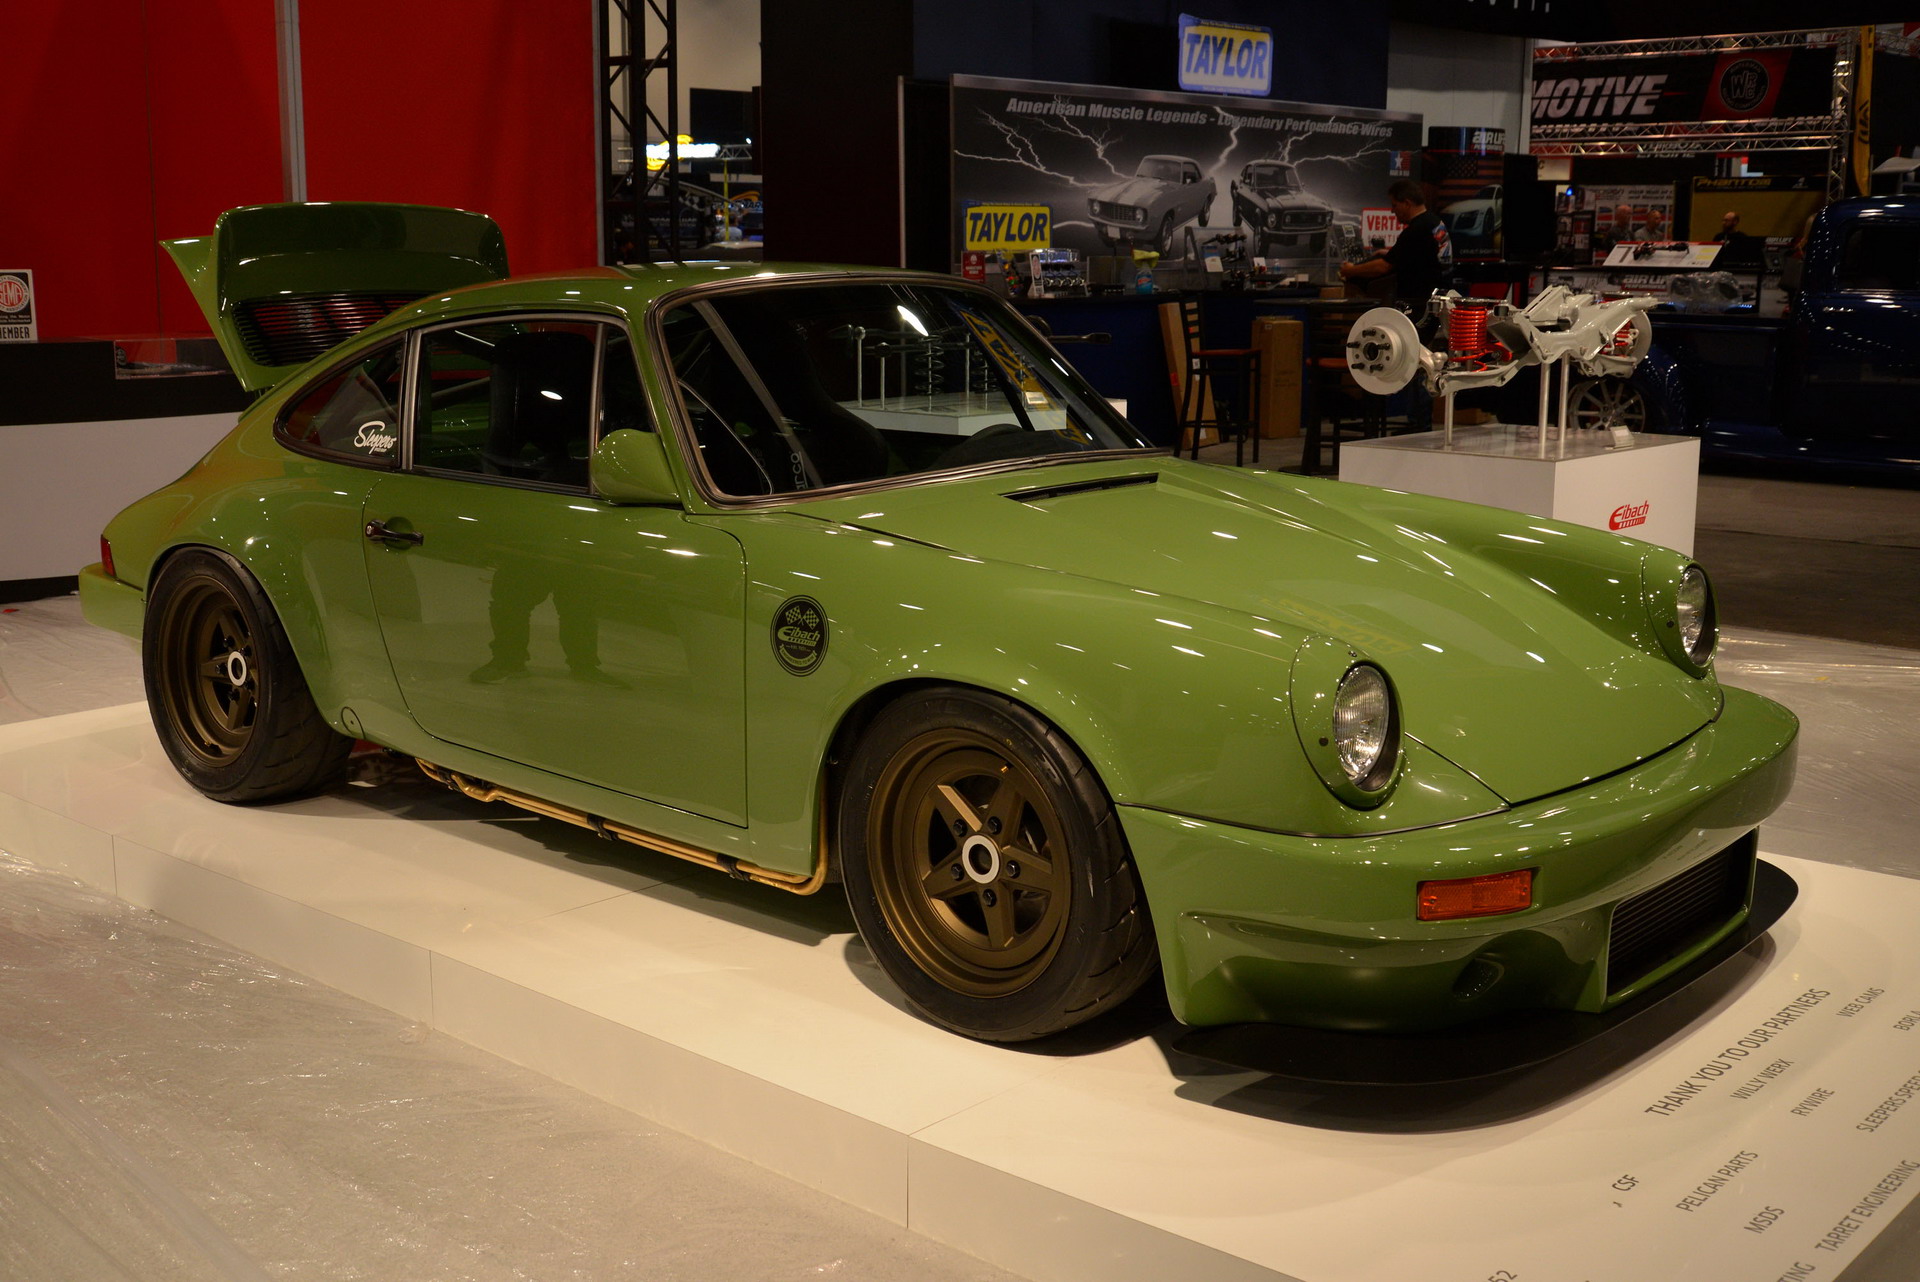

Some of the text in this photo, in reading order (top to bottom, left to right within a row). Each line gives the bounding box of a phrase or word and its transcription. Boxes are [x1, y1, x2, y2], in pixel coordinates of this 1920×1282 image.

[1186, 33, 1268, 79] TAYLOR
[1006, 98, 1085, 117] American
[1088, 103, 1143, 121] Muscle
[1146, 107, 1208, 125] Legends
[1218, 112, 1284, 130] Legendary
[1285, 117, 1358, 135] Performance
[1360, 124, 1393, 138] Wires
[969, 212, 1048, 242] TAYLOR
[1609, 500, 1649, 530] Eibach
[778, 626, 821, 647] Eibach
[1836, 987, 1885, 1018] WEB CAMS
[1644, 988, 1831, 1116] THANK YOU TO OUR PARTNERS
[1730, 1058, 1794, 1100] WILLY WERX
[1790, 1087, 1835, 1117] RYWIRE
[1856, 1096, 1907, 1133] SLEEPERS
[1612, 1174, 1639, 1191] CSF
[1675, 1150, 1759, 1213] PELICAN PARTS
[1743, 1205, 1785, 1234] MSDS
[1814, 1160, 1920, 1252] TARRET ENGINEERING
